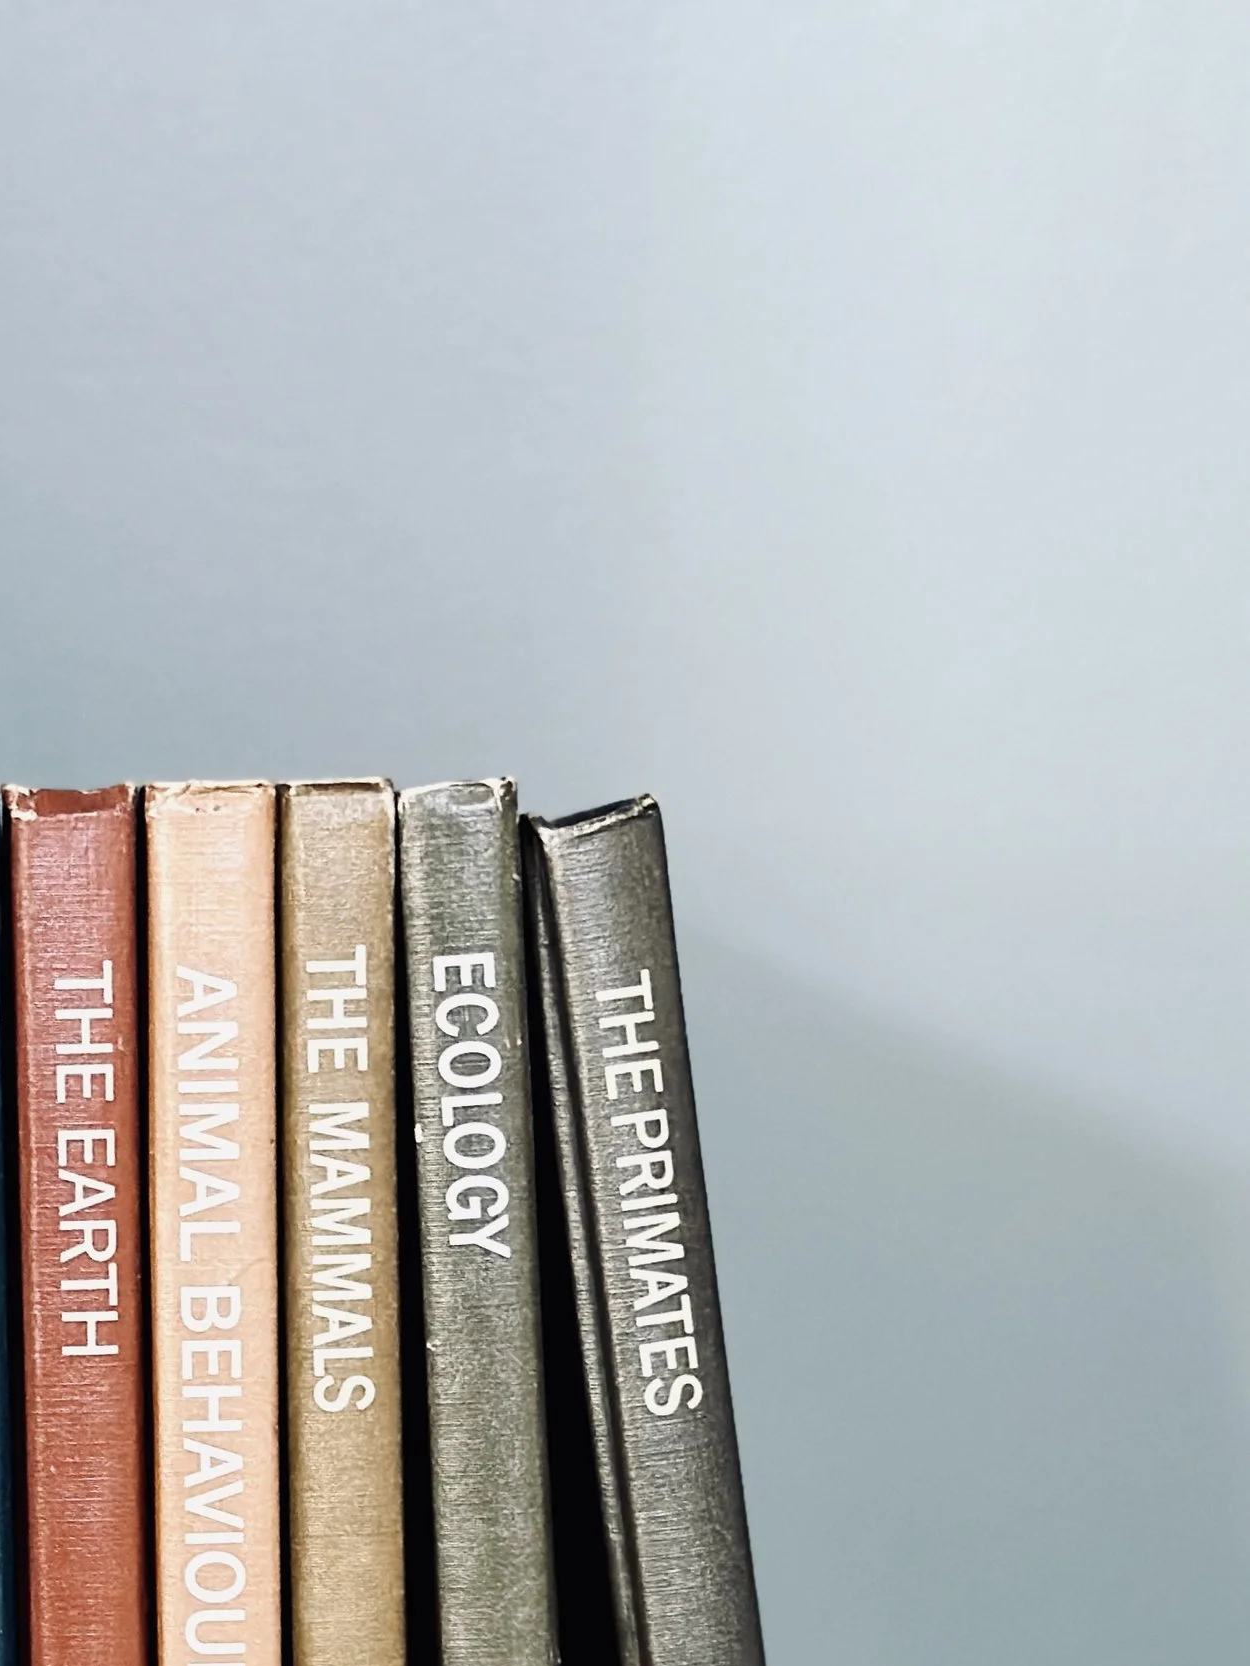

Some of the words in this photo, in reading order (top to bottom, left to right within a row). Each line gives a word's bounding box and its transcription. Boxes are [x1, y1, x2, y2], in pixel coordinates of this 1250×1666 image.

[52, 961, 114, 1104] THE
[177, 965, 240, 1262] ANIMAL
[303, 944, 368, 1073] THE
[432, 952, 511, 1258] ECOLOGY
[594, 969, 663, 1102] THE
[56, 1128, 119, 1358] EARTH
[308, 1101, 375, 1413] MAMMALS
[611, 1111, 703, 1418] PRIMATES
